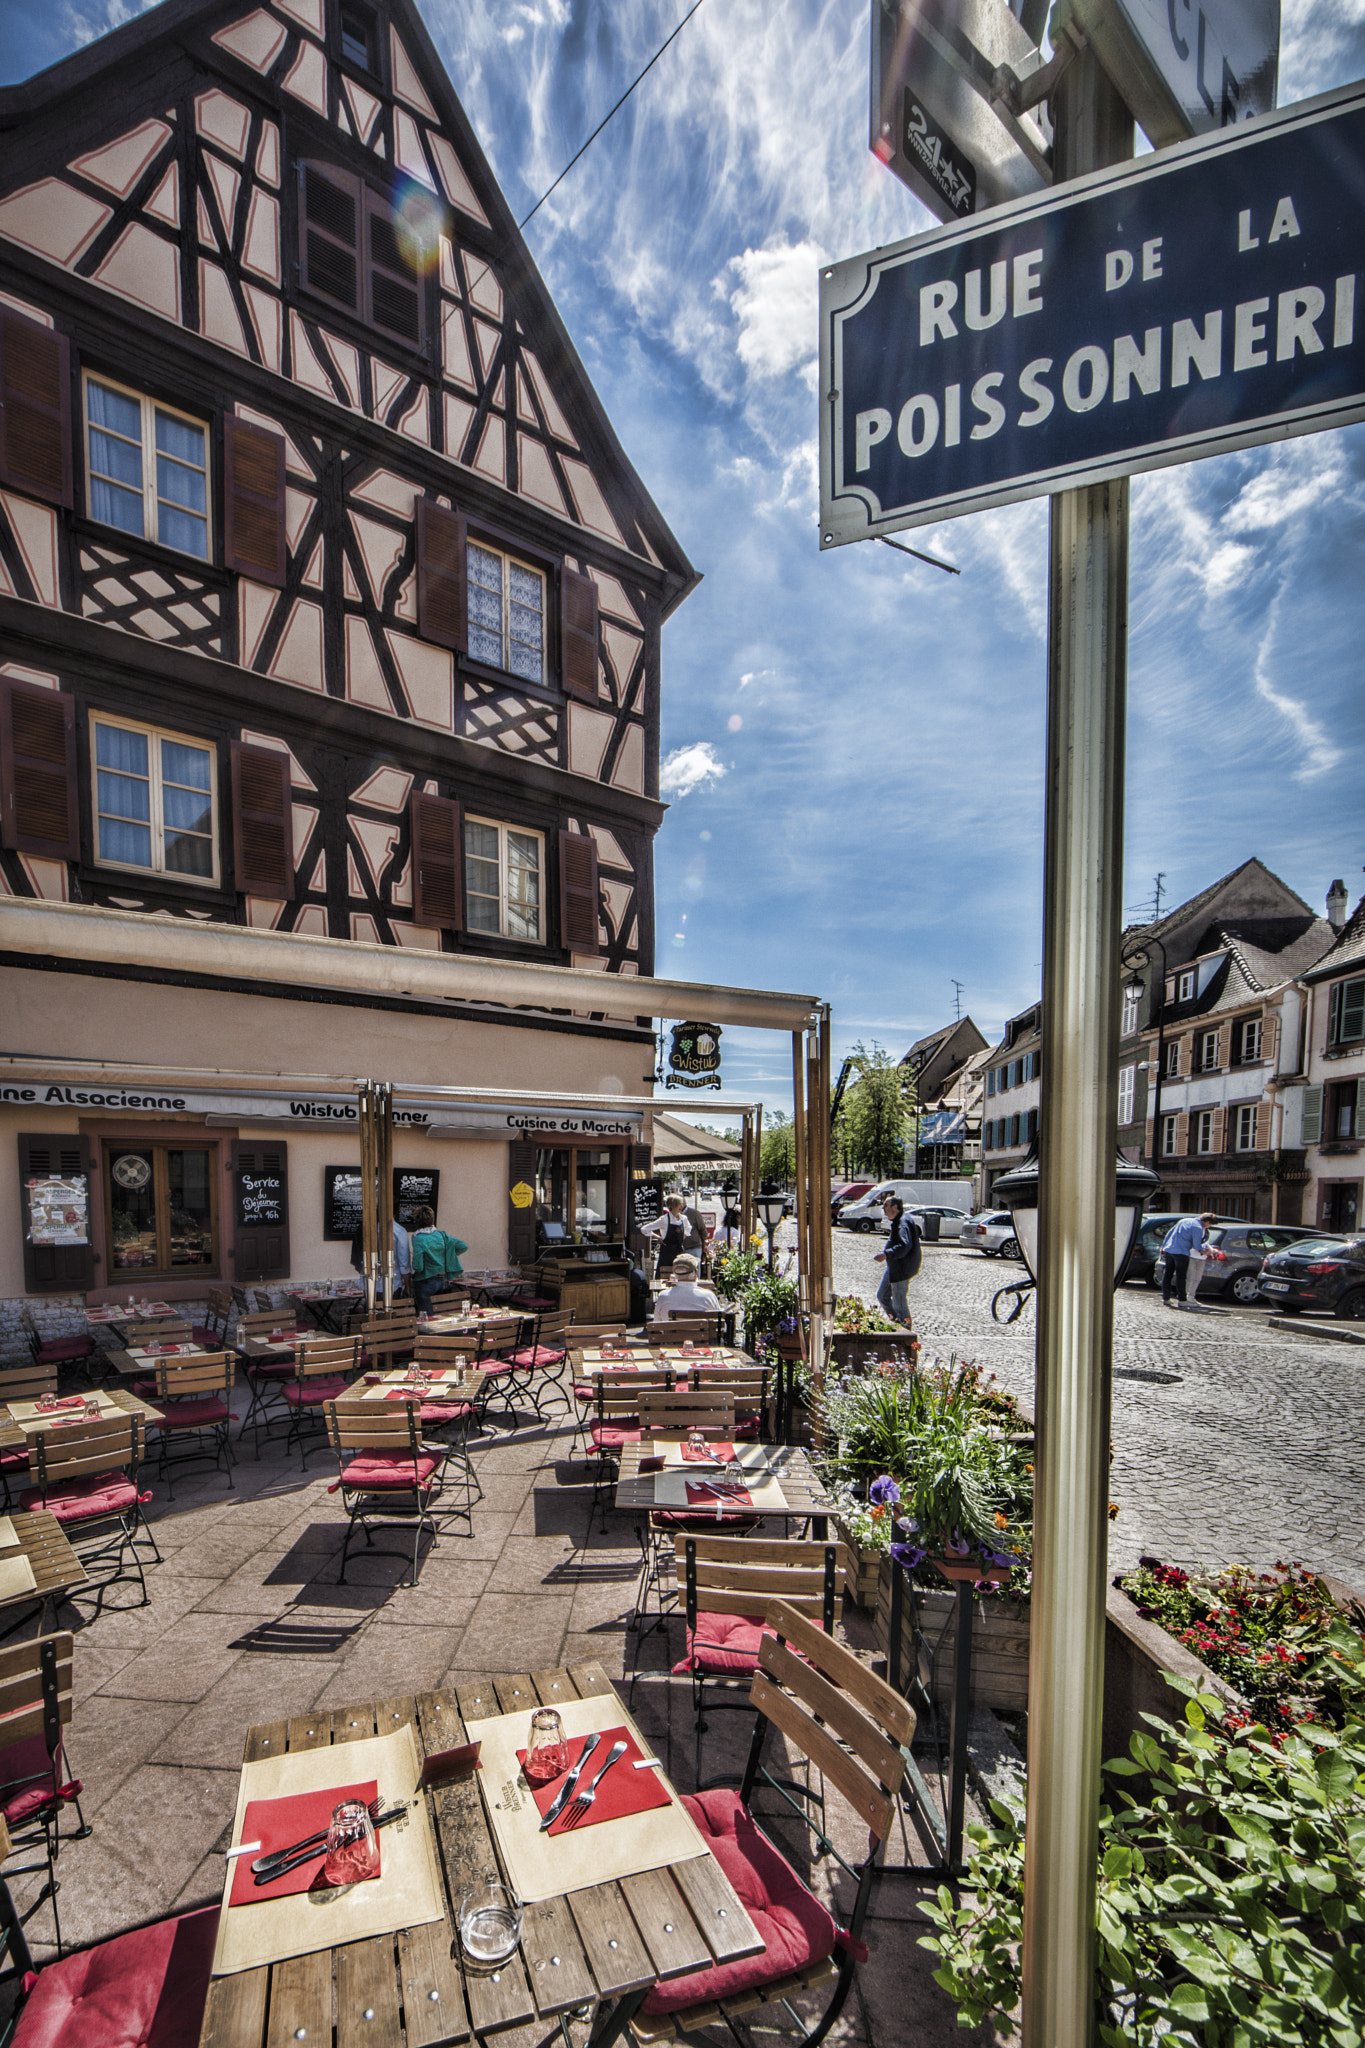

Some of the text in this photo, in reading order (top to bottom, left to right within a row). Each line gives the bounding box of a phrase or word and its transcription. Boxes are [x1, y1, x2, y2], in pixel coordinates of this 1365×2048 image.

[919, 195, 1301, 347] RUE DE LA
[855, 273, 1356, 473] POISSONNERI
[672, 1053, 717, 1070] Wistub
[669, 1075, 718, 1087] BRENNER
[0, 1086, 186, 1109] ne Alsacienne
[290, 1101, 429, 1122] Wistub nner
[506, 1115, 632, 1134] Cuisine du Marché
[242, 1174, 280, 1190] Service
[257, 1188, 267, 1199] du
[242, 1197, 281, 1212] Déjeuner
[265, 1210, 279, 1219] 16h
